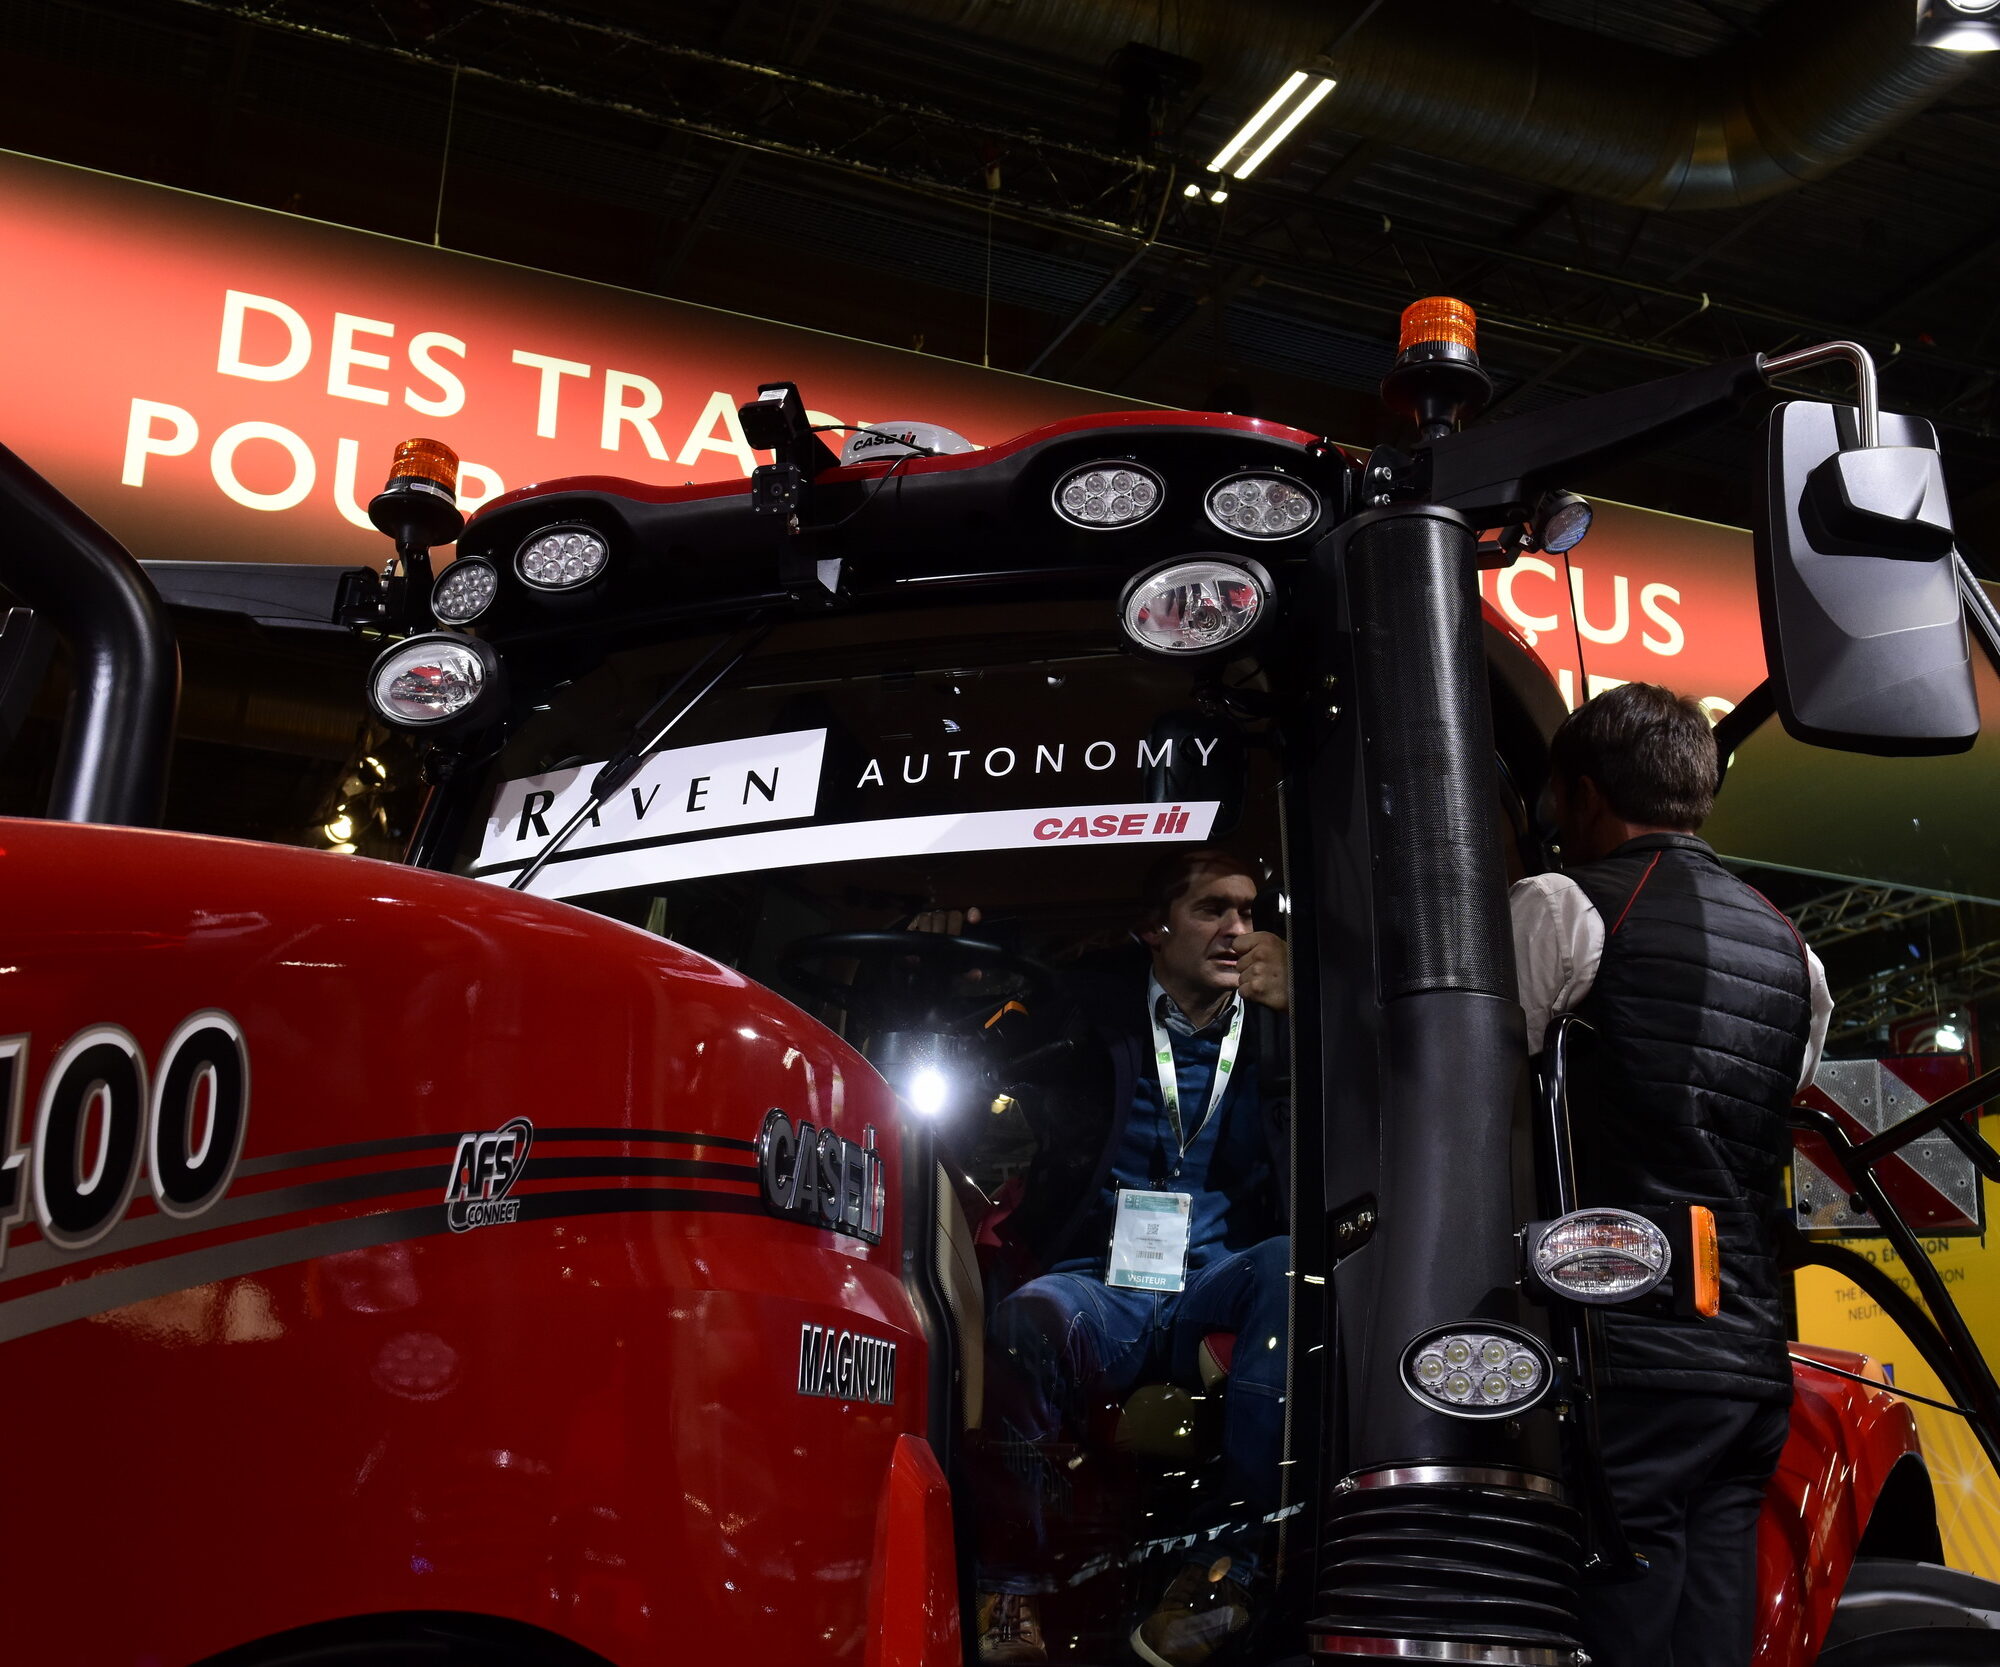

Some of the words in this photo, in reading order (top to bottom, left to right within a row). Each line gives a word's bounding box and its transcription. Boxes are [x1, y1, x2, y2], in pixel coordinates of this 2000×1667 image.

[216, 289, 467, 417] DES
[857, 737, 1218, 788] AUTONOMY
[1033, 814, 1148, 841] CASE
[444, 1131, 518, 1203] AFS
[759, 1107, 864, 1231] CASE
[466, 1199, 520, 1227] CONNECT
[1835, 1289, 1856, 1303] THE
[799, 1322, 896, 1405] MAGNUM
